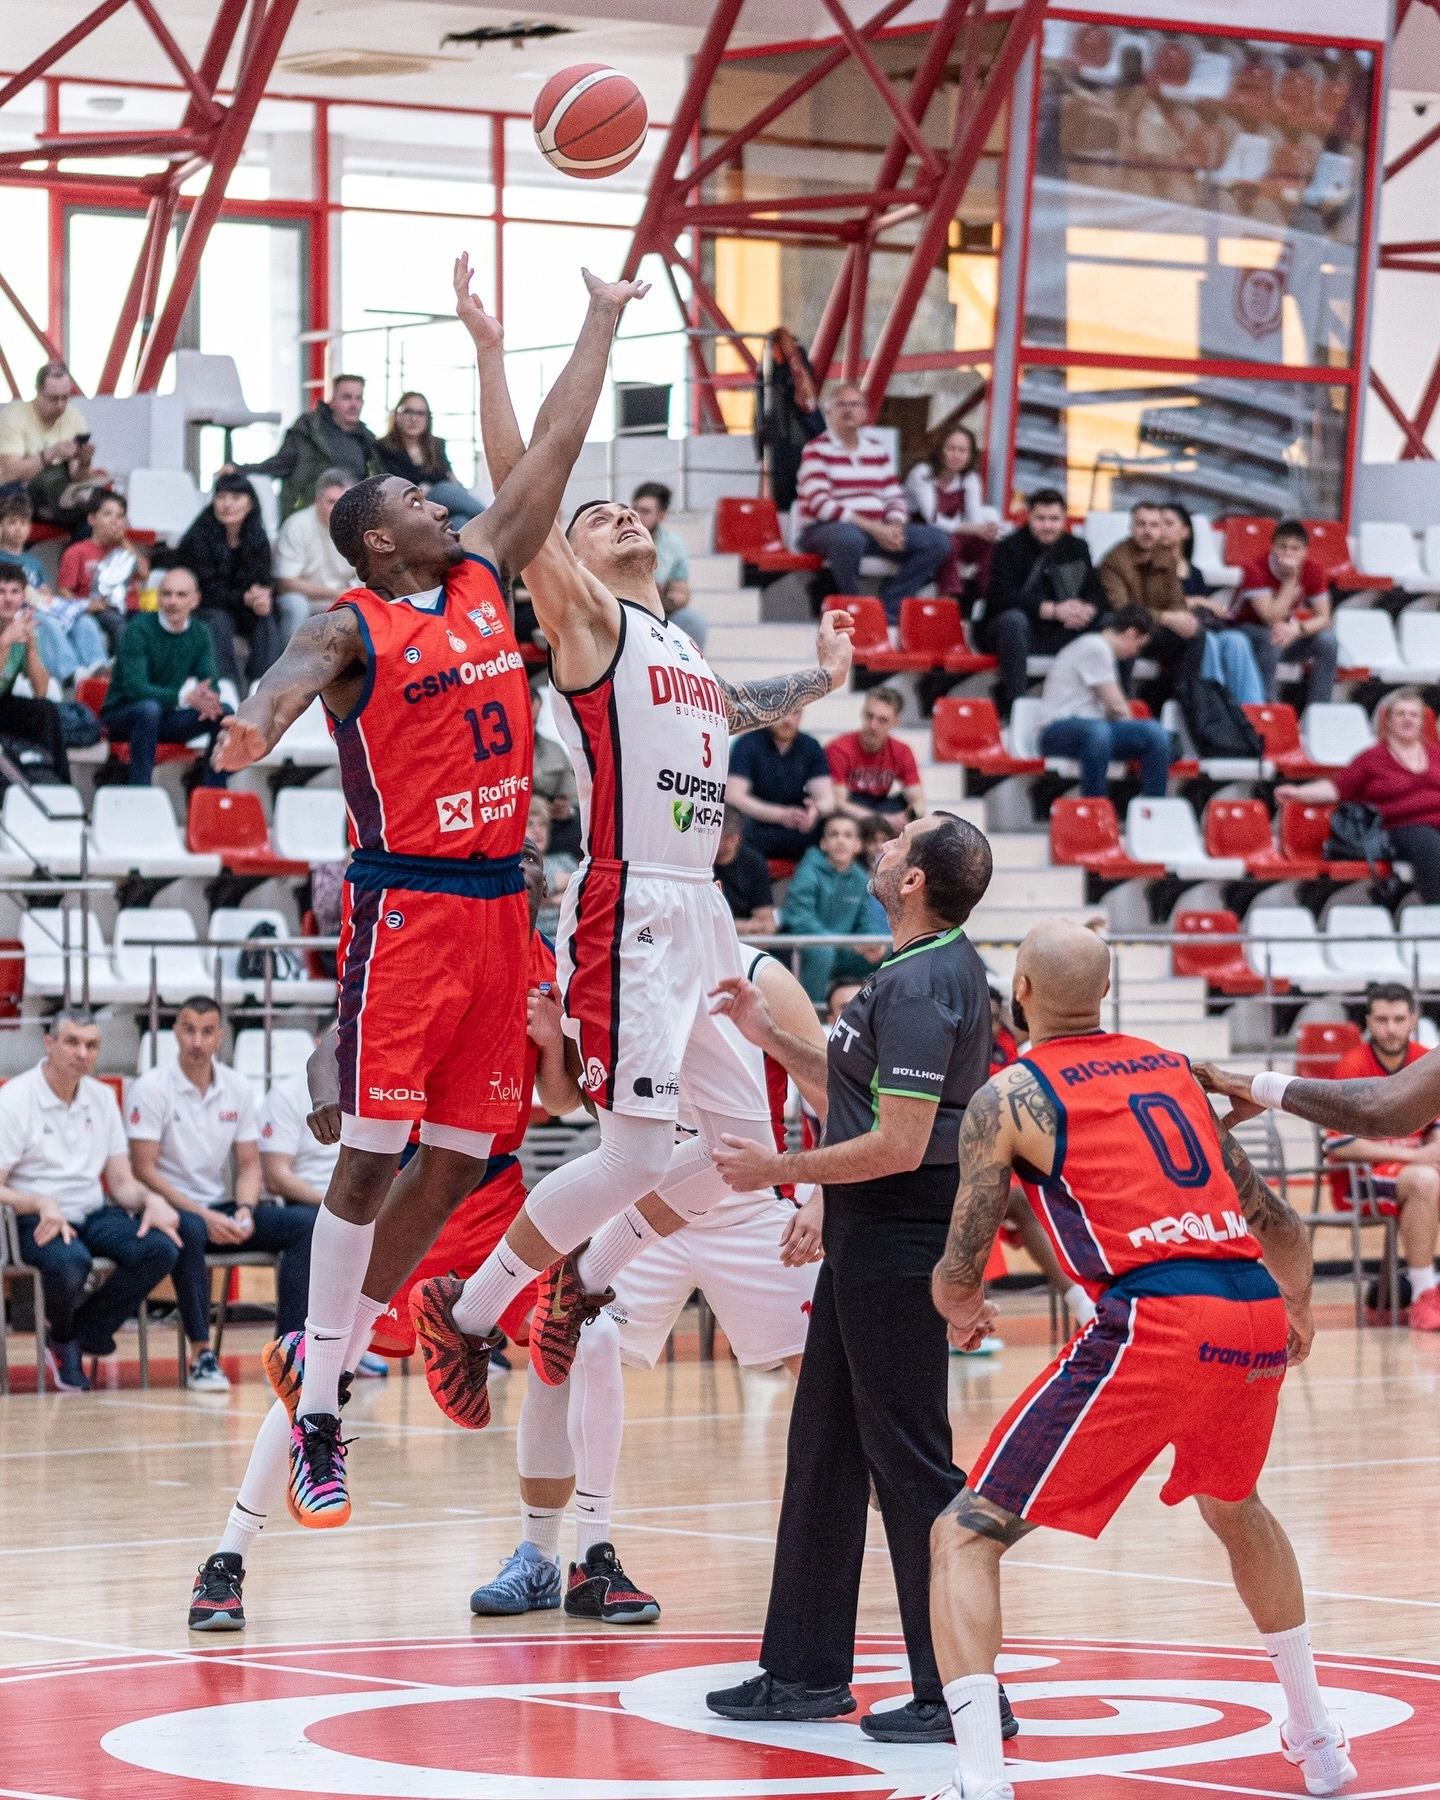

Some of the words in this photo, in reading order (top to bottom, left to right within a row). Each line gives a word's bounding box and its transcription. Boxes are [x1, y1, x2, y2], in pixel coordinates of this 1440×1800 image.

[464, 701, 514, 762] 13
[701, 732, 712, 768] 3
[637, 936, 654, 945] PEAK
[830, 1014, 861, 1053] FT
[369, 1086, 427, 1101] SKOD
[655, 1082, 679, 1096] affi
[1127, 1091, 1211, 1188] 0
[1199, 1342, 1252, 1367] trans
